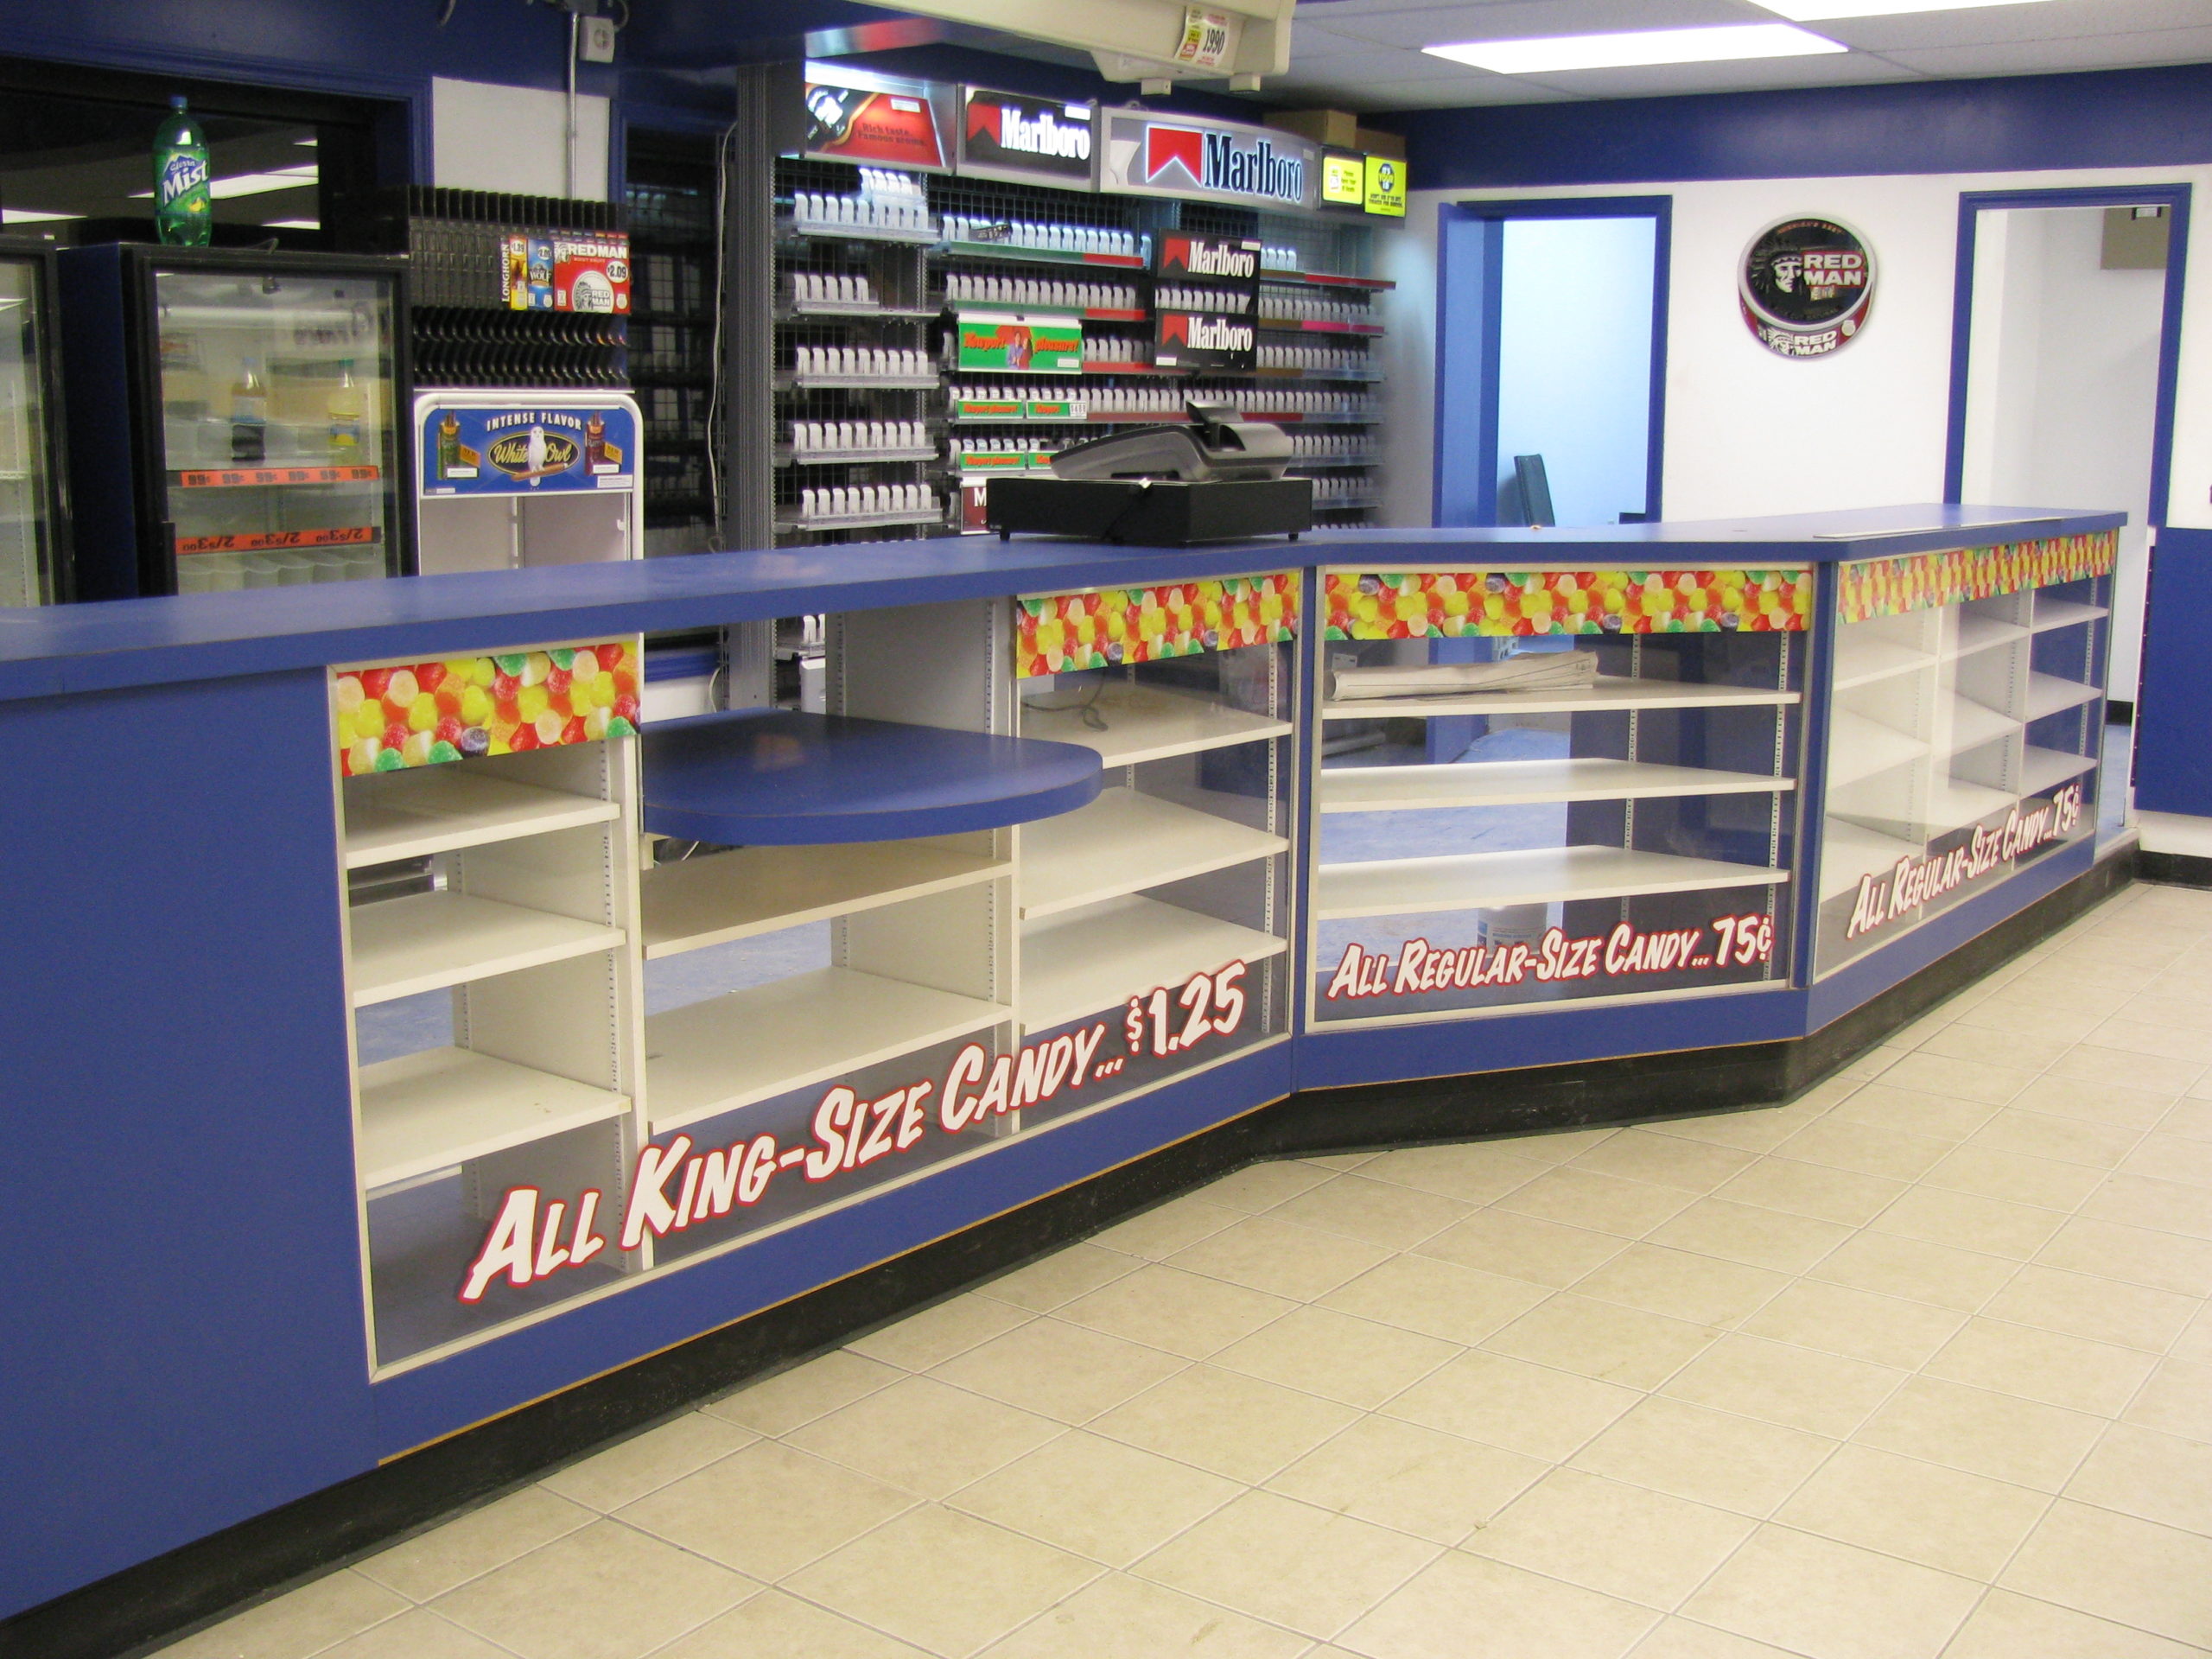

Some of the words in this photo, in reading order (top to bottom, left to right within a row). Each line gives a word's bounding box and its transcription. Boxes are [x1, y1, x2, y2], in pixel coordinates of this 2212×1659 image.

[1203, 29, 1225, 55] 1990
[1001, 107, 1090, 160] Marlboro
[162, 159, 208, 207] Mist
[1204, 131, 1302, 202] Marlboro
[501, 244, 510, 302] LONGHORN
[530, 270, 552, 283] WOLF
[1188, 240, 1255, 278] Marlboro
[1803, 254, 1862, 269] RED
[1803, 270, 1861, 285] MAN
[1187, 317, 1253, 352] Marlboro
[1794, 331, 1837, 346] RED
[1795, 340, 1836, 355] MAN
[486, 412, 536, 431] INTENSE
[541, 412, 582, 431] FLAVOR
[494, 442, 529, 463] White
[545, 442, 572, 462] Owl
[1847, 874, 1885, 940] ALL
[1326, 943, 1387, 1001] ALL
[1392, 925, 1603, 996] REGULAR-SIZE
[458, 1188, 604, 1304] ALL
[619, 1081, 932, 1251] KING-SIZE
[1125, 959, 1249, 1060] $1.25
